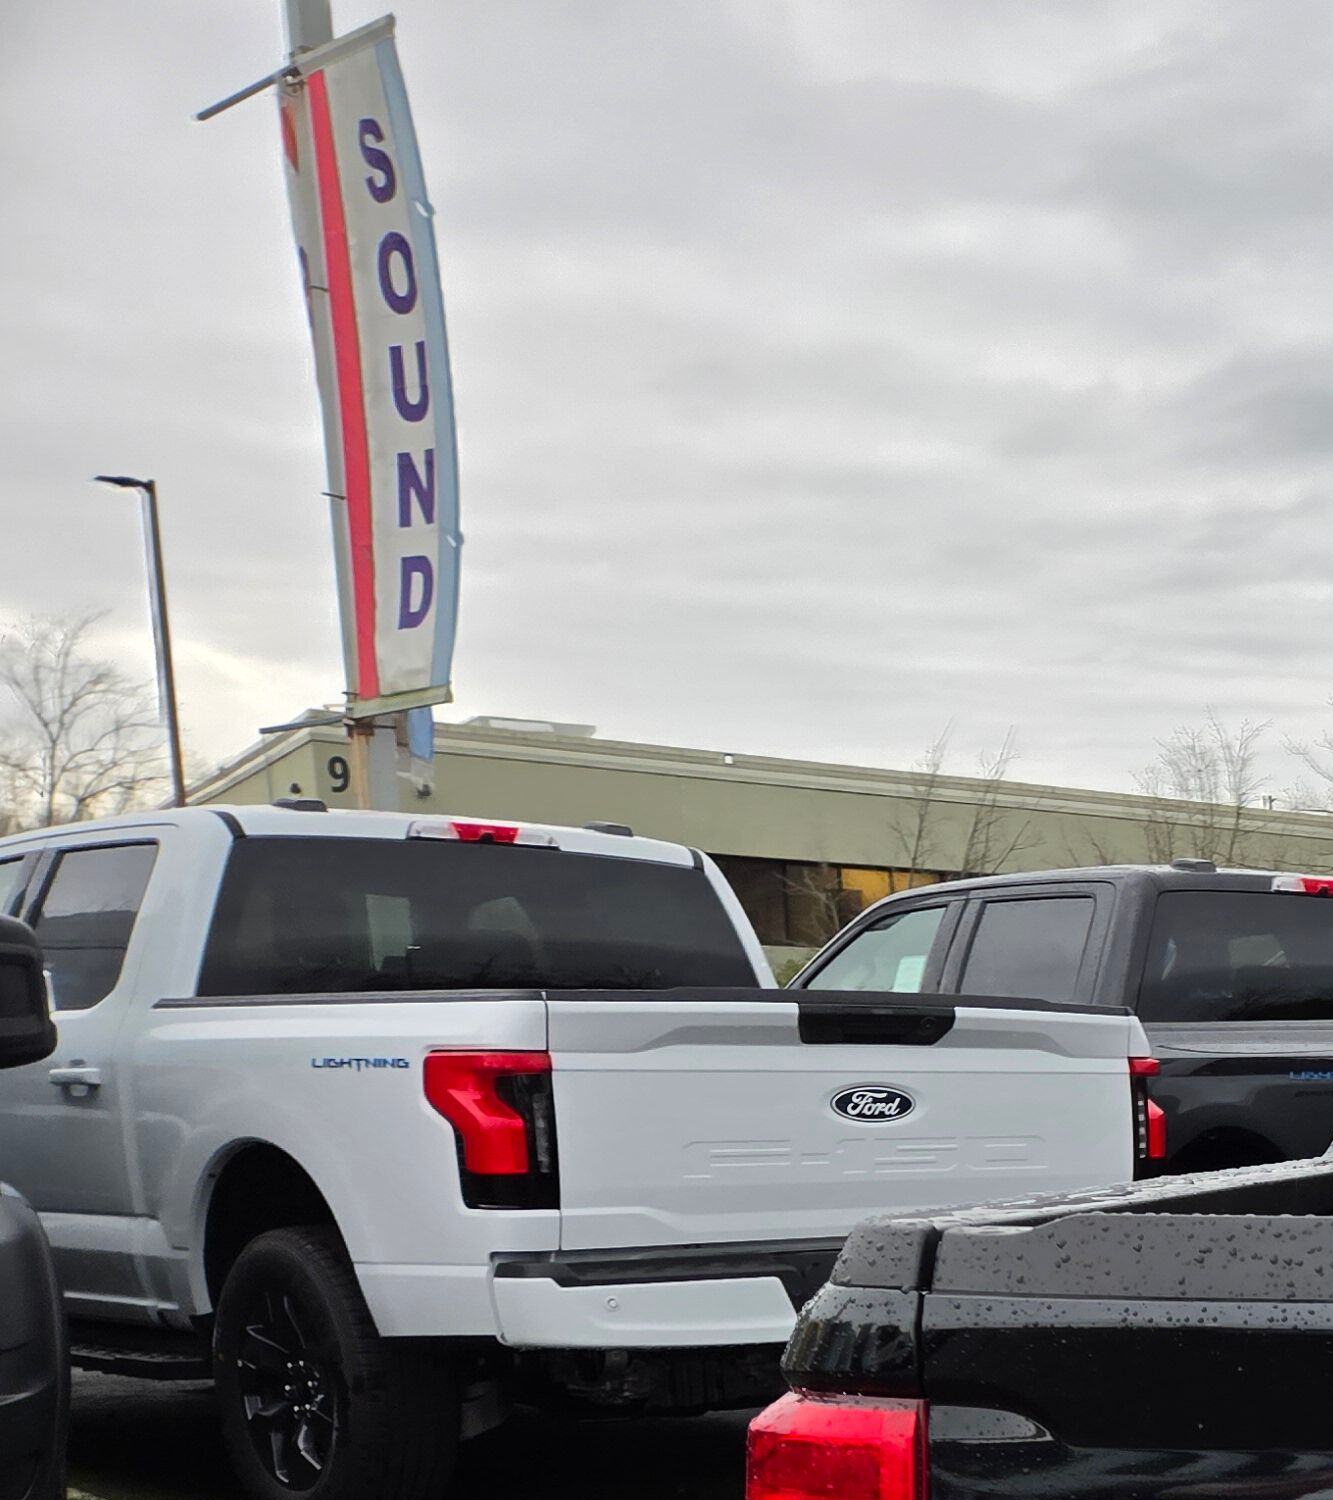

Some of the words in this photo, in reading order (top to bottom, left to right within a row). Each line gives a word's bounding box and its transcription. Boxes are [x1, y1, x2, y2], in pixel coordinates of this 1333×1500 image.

[357, 117, 437, 630] SOUND
[327, 756, 349, 793] 9
[311, 1058, 410, 1072] LIGHTNING
[845, 1091, 901, 1117] Ford
